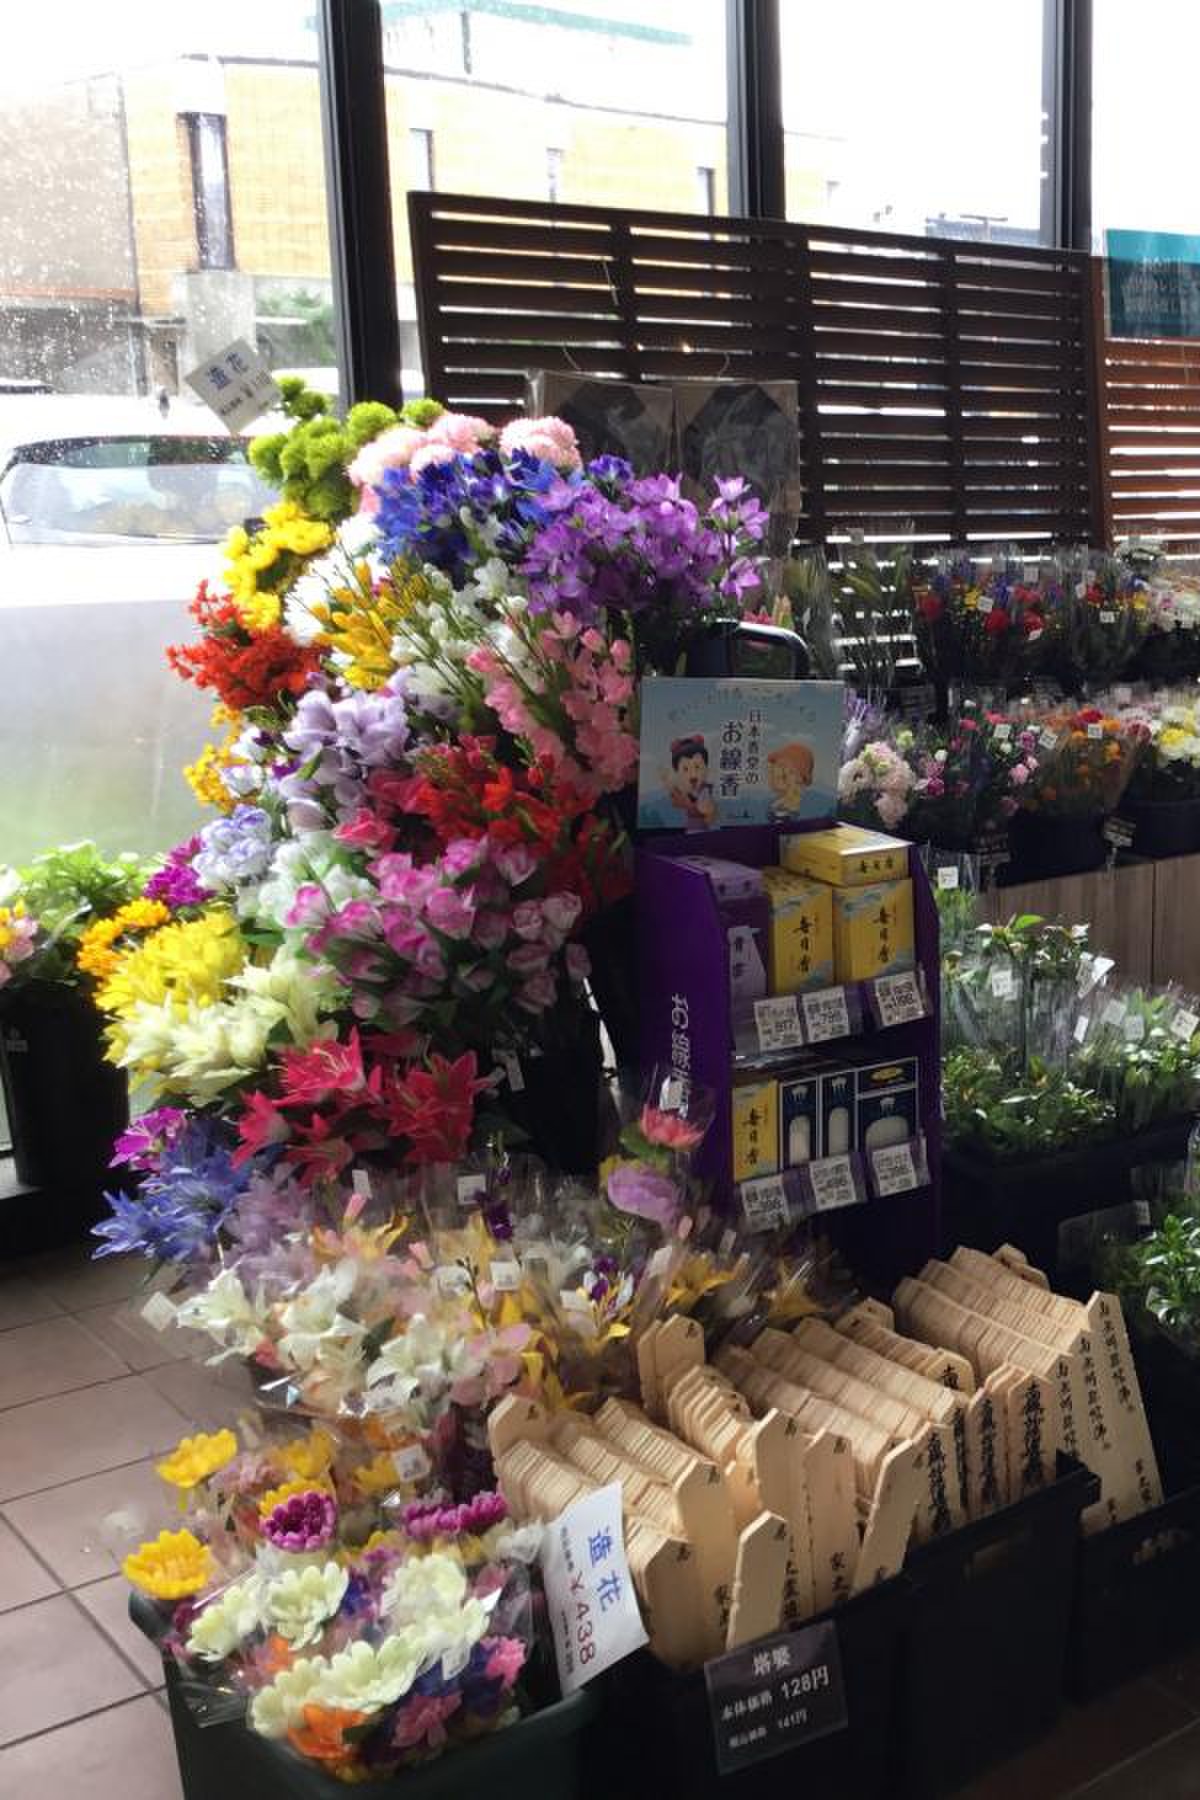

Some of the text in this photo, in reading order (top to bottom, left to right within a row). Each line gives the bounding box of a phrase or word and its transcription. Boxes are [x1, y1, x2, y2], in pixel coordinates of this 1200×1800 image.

[721, 721, 746, 797] お線香
[745, 709, 761, 785] 日本香堂の
[781, 1664, 830, 1699] 128円
